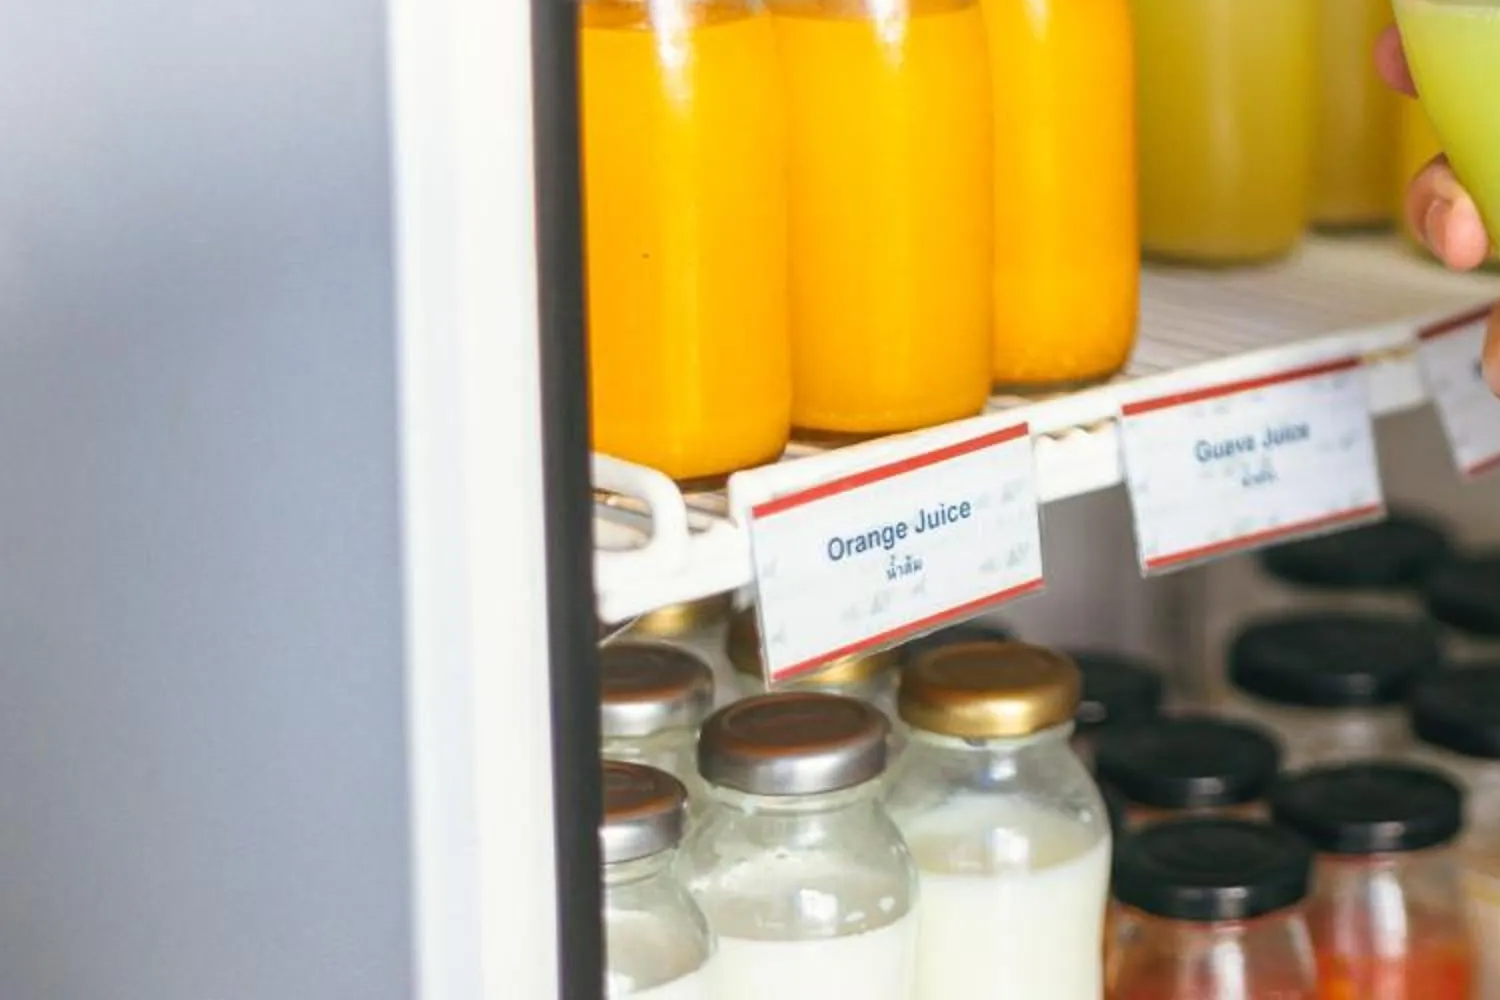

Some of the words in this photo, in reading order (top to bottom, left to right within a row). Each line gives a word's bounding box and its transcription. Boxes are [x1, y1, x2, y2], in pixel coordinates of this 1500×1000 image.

[1193, 435, 1256, 463] Guava
[1262, 422, 1310, 449] Juice
[827, 521, 908, 561] Orange
[915, 500, 972, 534] Juice
